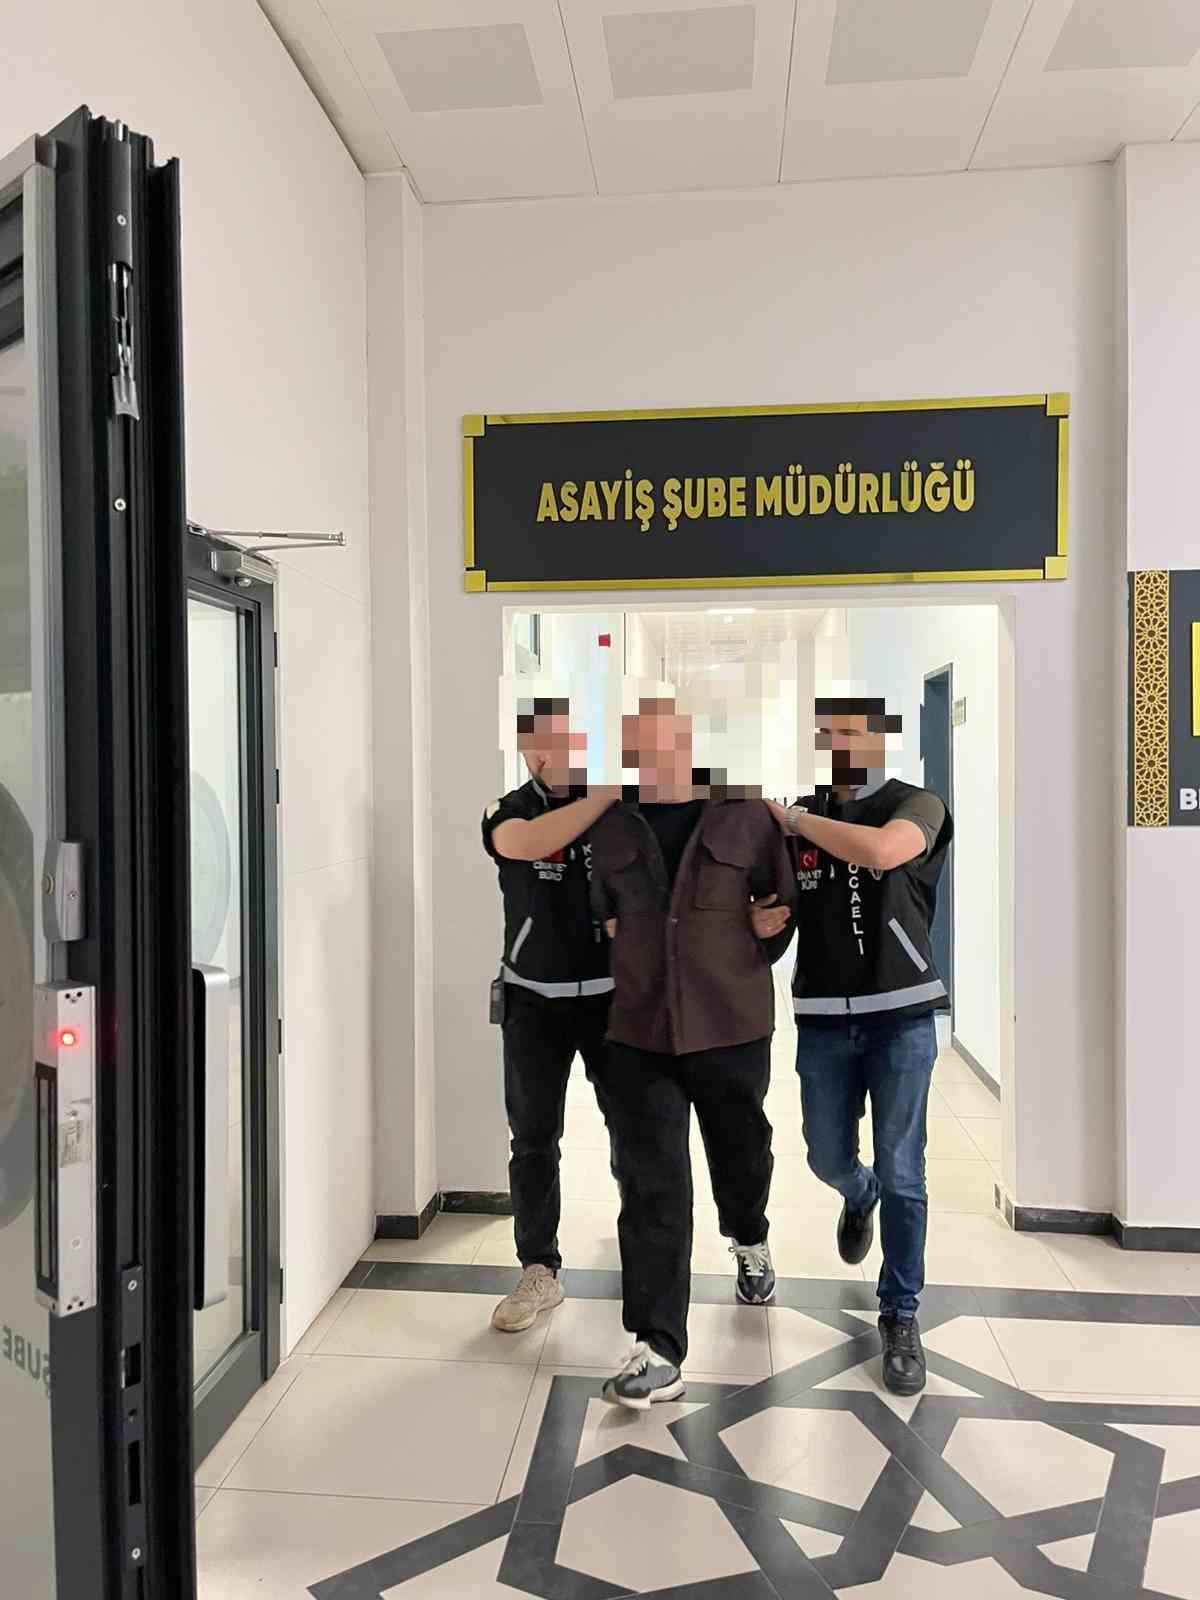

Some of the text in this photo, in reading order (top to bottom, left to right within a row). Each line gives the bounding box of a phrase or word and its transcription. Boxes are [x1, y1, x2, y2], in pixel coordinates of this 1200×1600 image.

[536, 459, 976, 532] ASAYİŞ ŞUBE MÜDÜRLÜĞÜ
[1179, 787, 1200, 810] B
